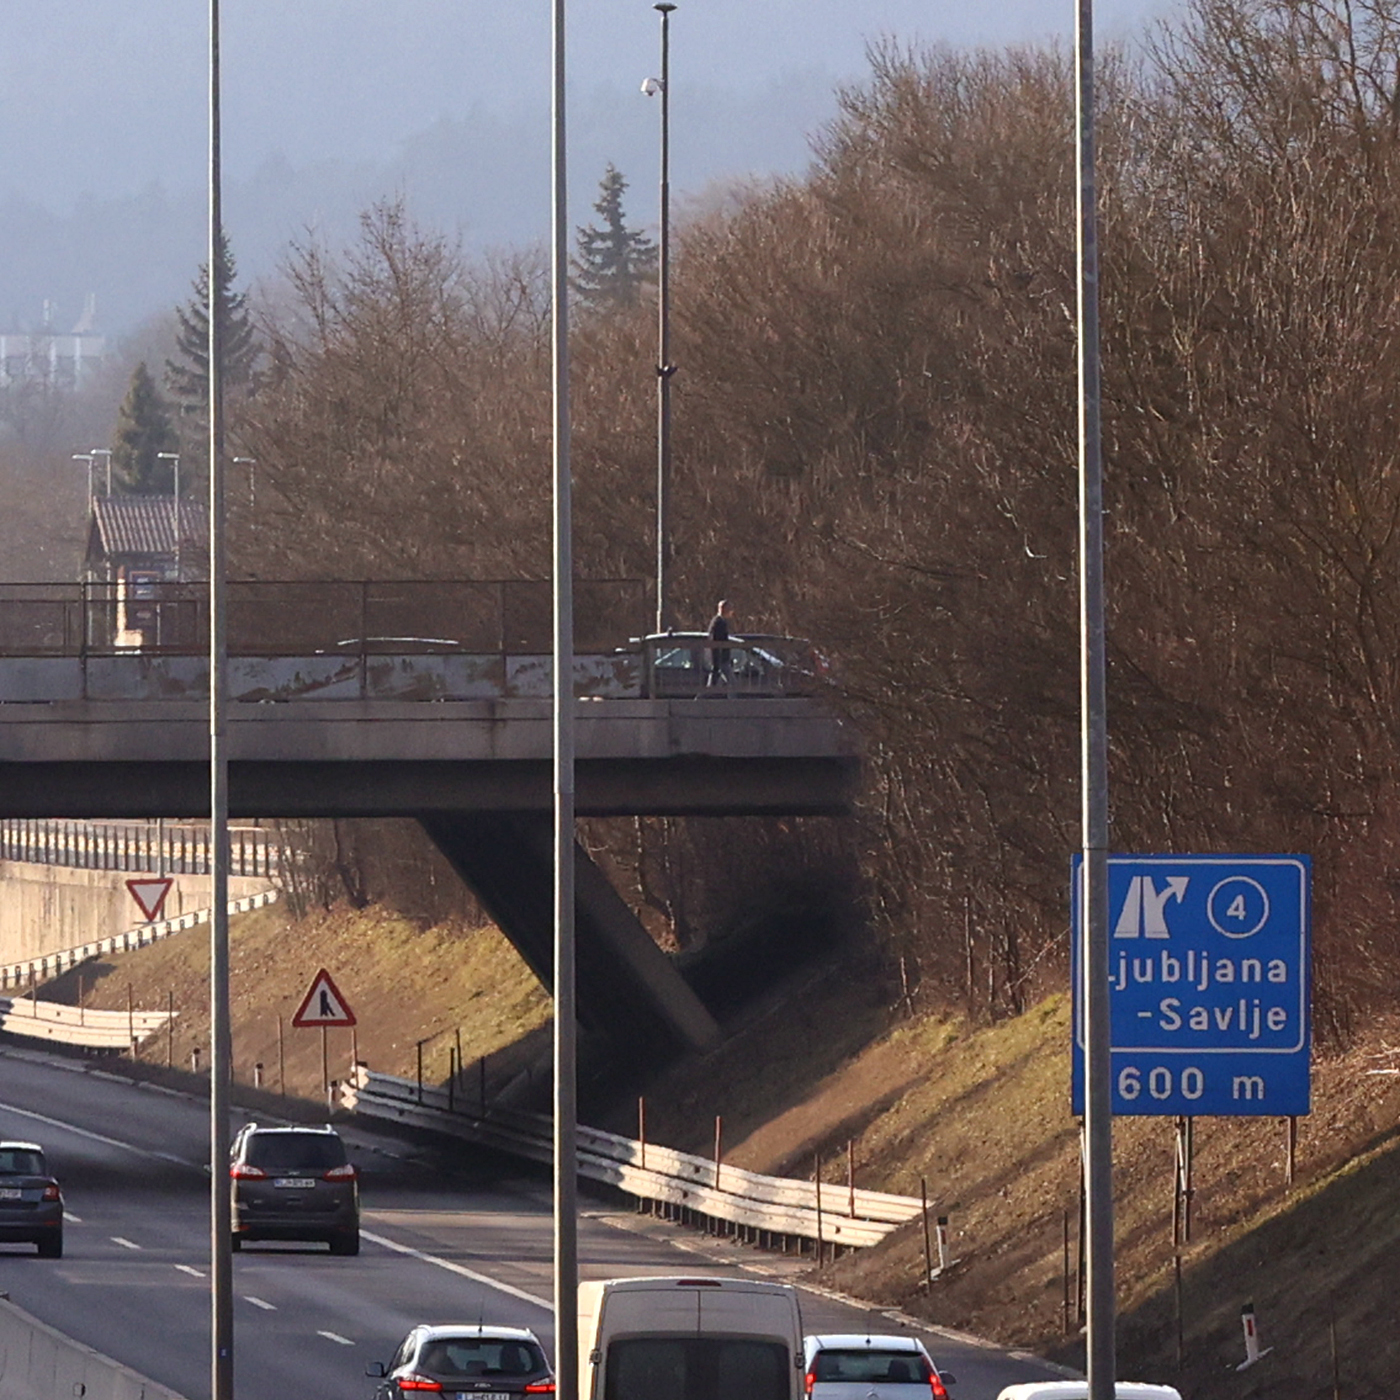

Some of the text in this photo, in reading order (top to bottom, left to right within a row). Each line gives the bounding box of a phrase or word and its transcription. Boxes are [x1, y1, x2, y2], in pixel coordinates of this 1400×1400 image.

[1226, 894, 1247, 921] 4
[1107, 949, 1288, 991] jubljana
[1117, 1066, 1265, 1100] 600 m
